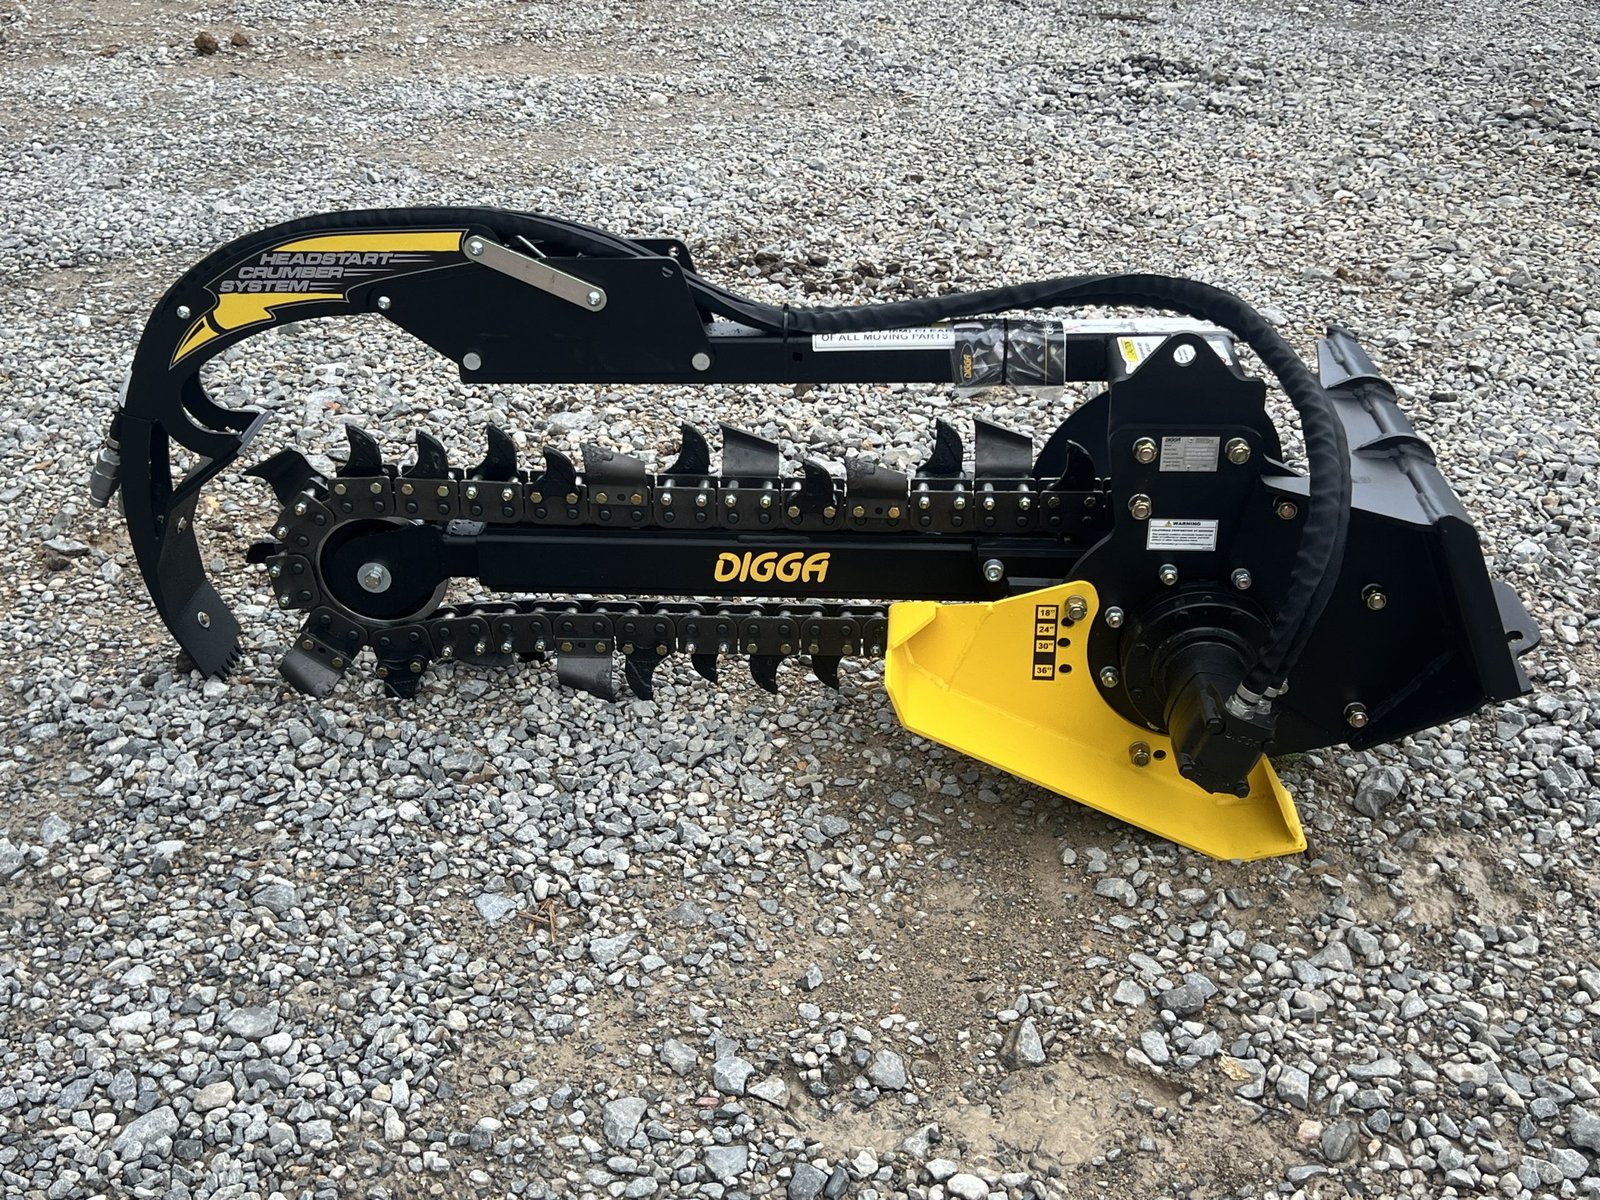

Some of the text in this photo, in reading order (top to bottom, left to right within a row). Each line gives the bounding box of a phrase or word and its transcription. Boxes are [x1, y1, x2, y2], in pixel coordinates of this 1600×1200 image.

[259, 253, 394, 265] HEADSTART
[238, 266, 345, 279] CRUMBER
[219, 280, 311, 292] SYSTEM
[821, 334, 835, 342] OF
[863, 333, 909, 341] MOVING
[963, 354, 973, 379] DIGGA
[714, 551, 831, 583] DIGGA
